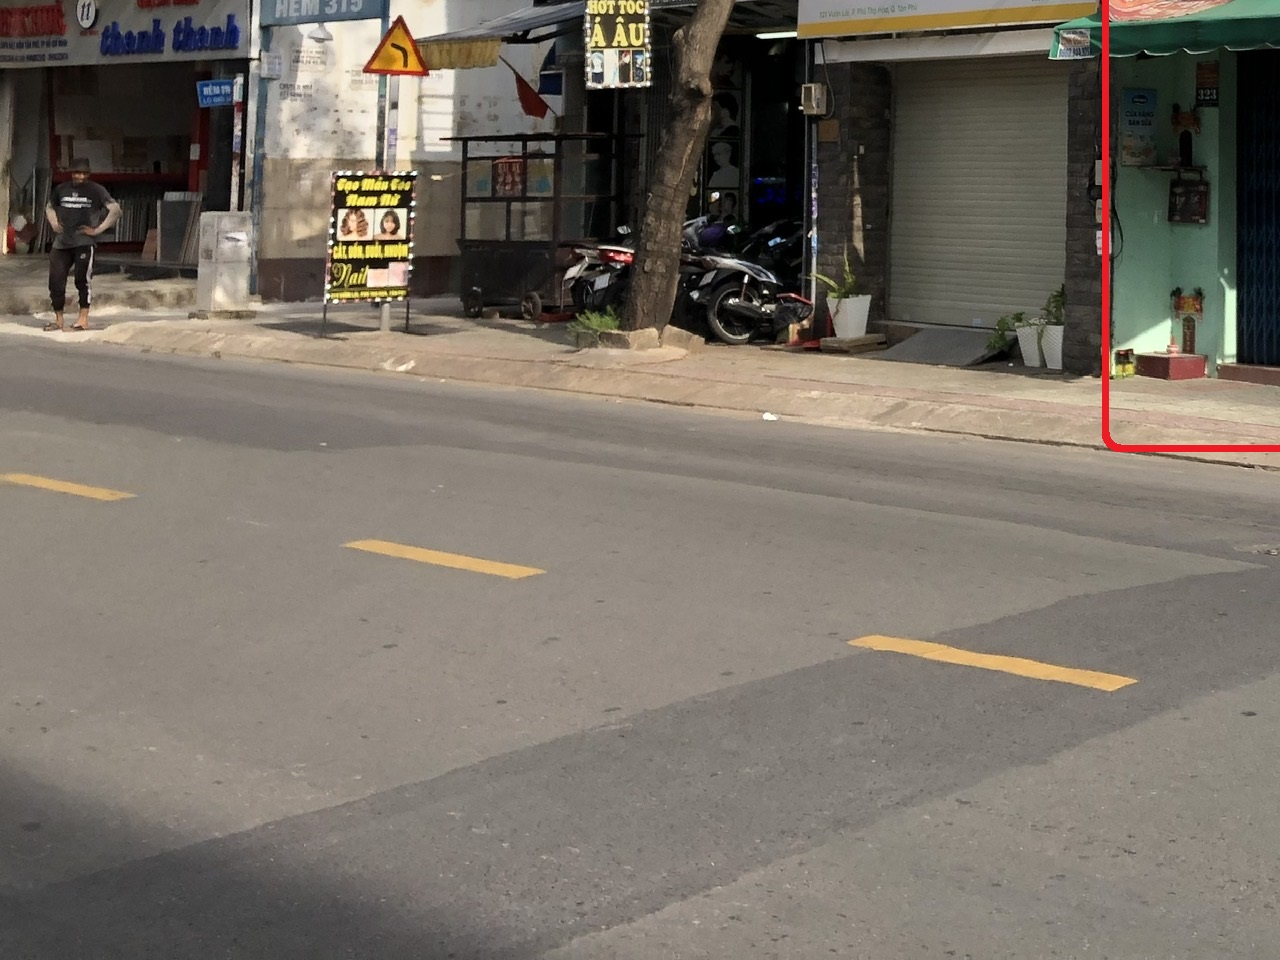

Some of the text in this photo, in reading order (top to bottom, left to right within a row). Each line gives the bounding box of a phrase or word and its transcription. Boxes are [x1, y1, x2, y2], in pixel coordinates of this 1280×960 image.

[590, 16, 644, 47] Á ÂU
[1198, 89, 1217, 100] 323
[332, 262, 369, 288] Nail
